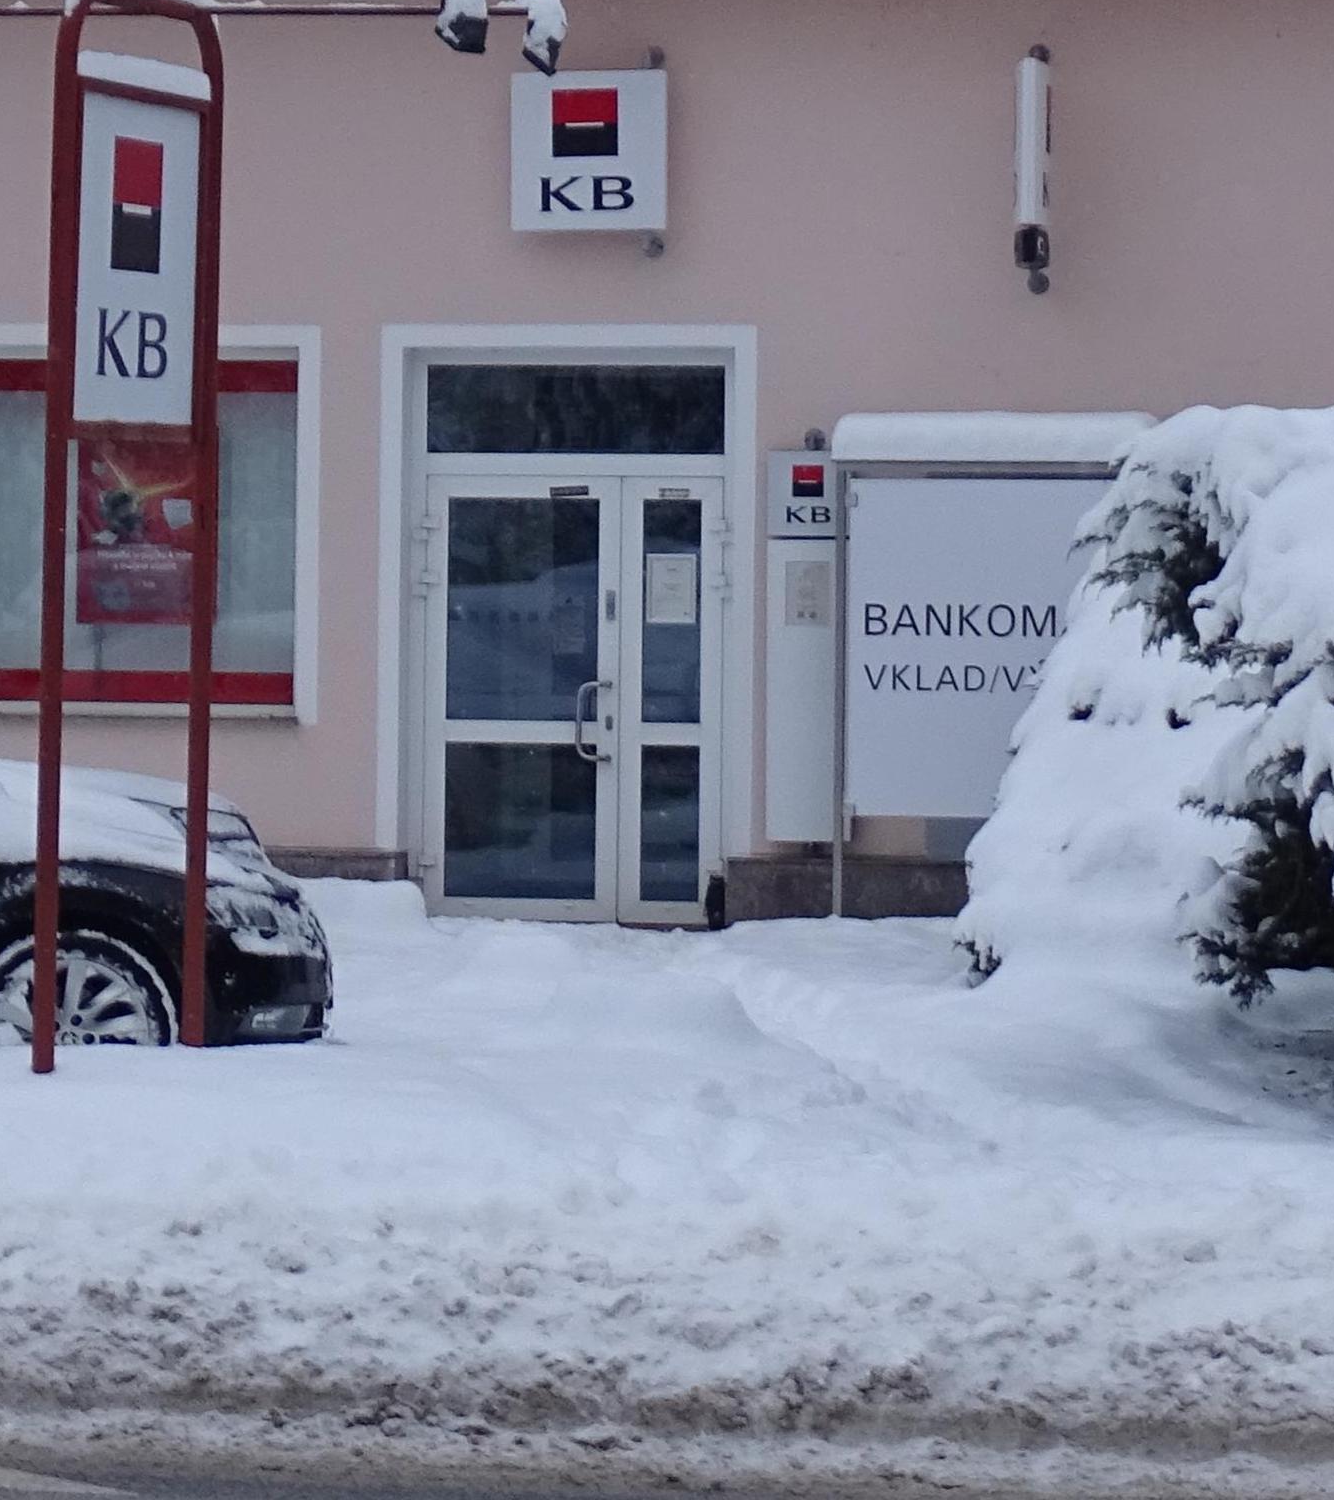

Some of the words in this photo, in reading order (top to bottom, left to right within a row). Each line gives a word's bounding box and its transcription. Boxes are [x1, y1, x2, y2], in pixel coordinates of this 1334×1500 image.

[540, 176, 634, 212] KB
[97, 306, 167, 378] KB
[786, 506, 831, 524] KB
[864, 603, 1067, 637] BANKOM
